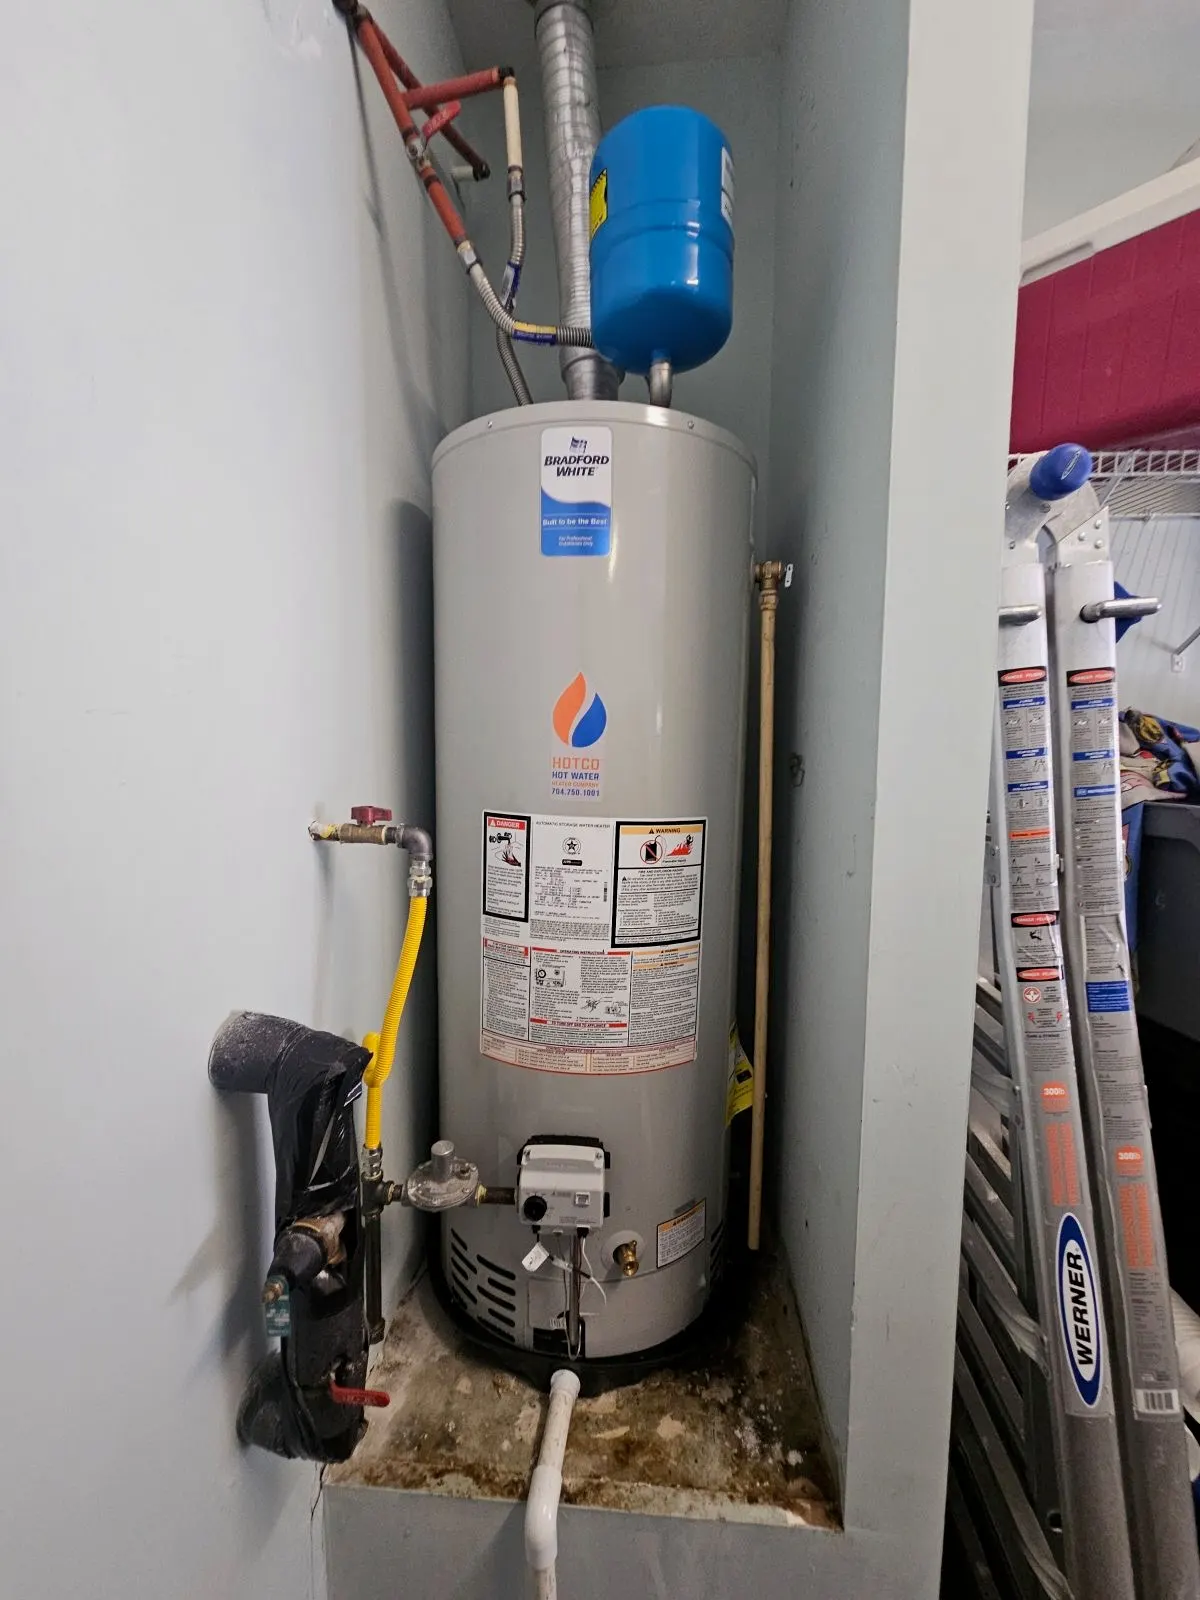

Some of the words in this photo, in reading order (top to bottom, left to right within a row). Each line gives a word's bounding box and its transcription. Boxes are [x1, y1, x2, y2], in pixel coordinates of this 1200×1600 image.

[544, 456, 610, 466] BRADFORD
[556, 467, 596, 477] WHITE
[578, 517, 589, 525] the
[591, 517, 608, 525] Best
[552, 757, 600, 770] HOTCO
[552, 771, 568, 779] HOT
[571, 772, 600, 781] WATER
[551, 788, 600, 797] 704.750.1001
[496, 820, 520, 829] DANGER
[1043, 1087, 1065, 1096] 300lb
[1066, 1249, 1094, 1365] WERNER
